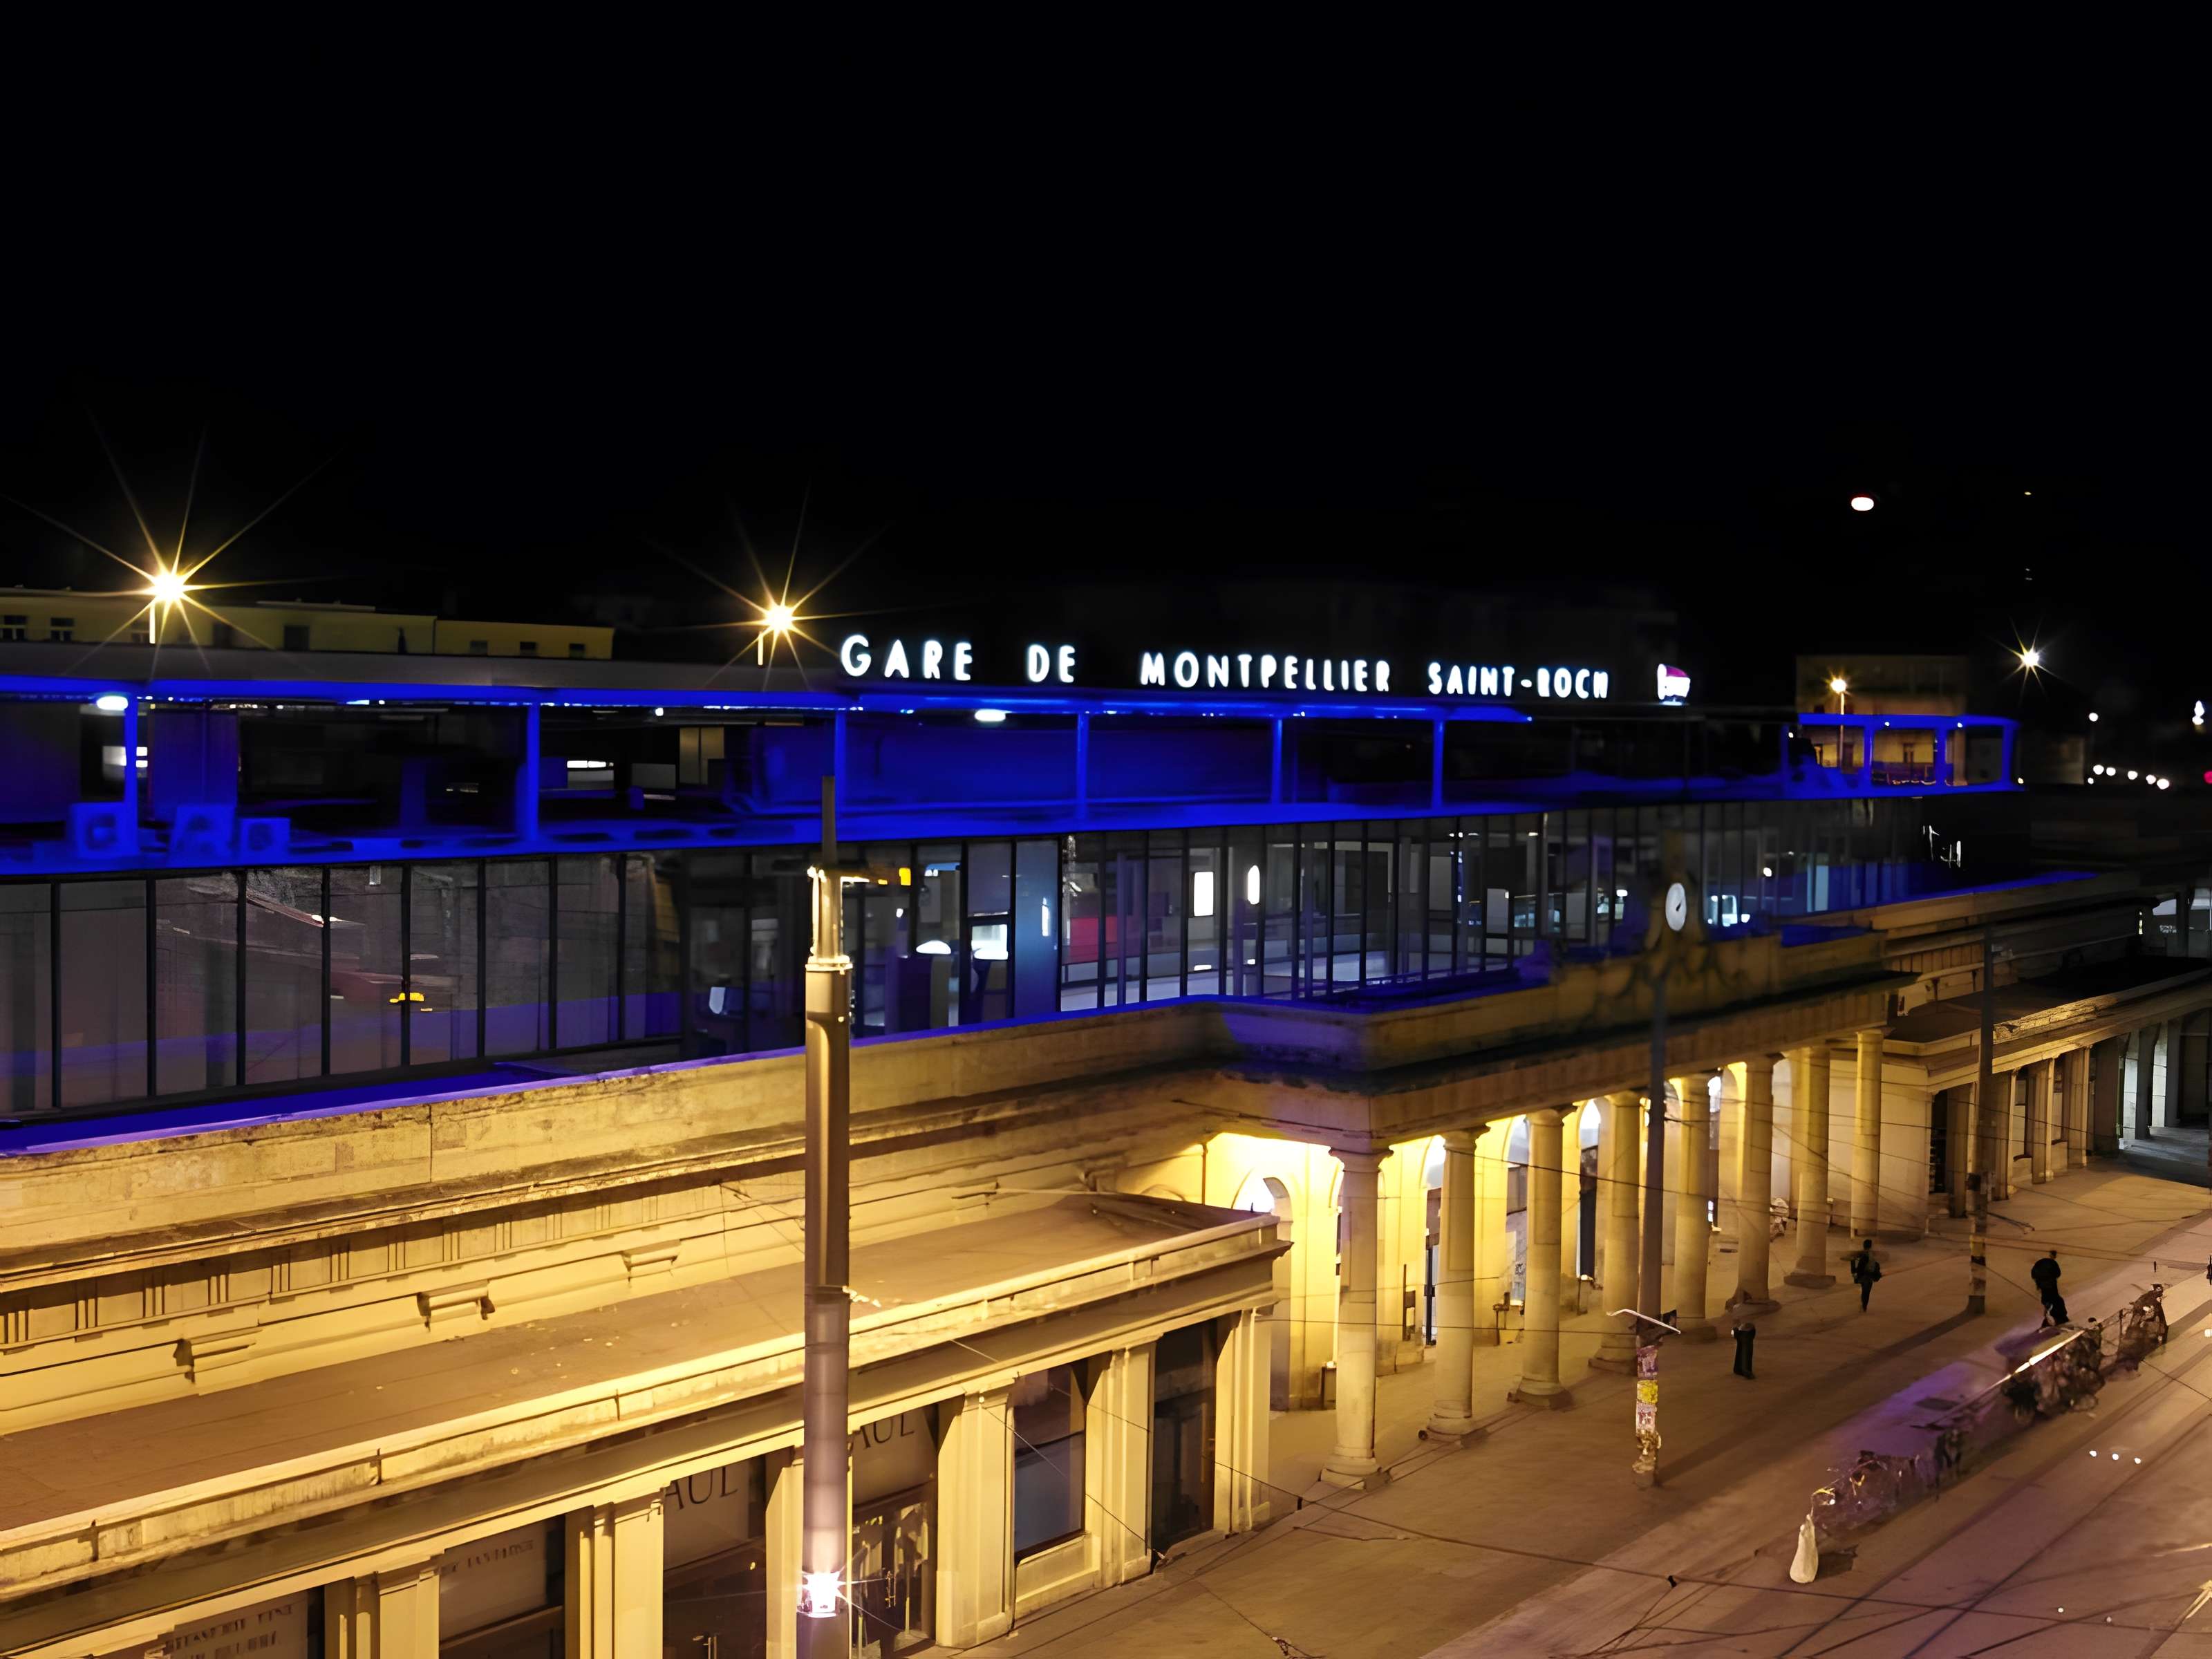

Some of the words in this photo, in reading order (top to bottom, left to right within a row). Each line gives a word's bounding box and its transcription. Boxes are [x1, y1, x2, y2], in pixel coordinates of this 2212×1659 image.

[839, 633, 973, 682] GARE
[1027, 643, 1076, 684] DE
[1139, 650, 1391, 693] MONTPELLIER
